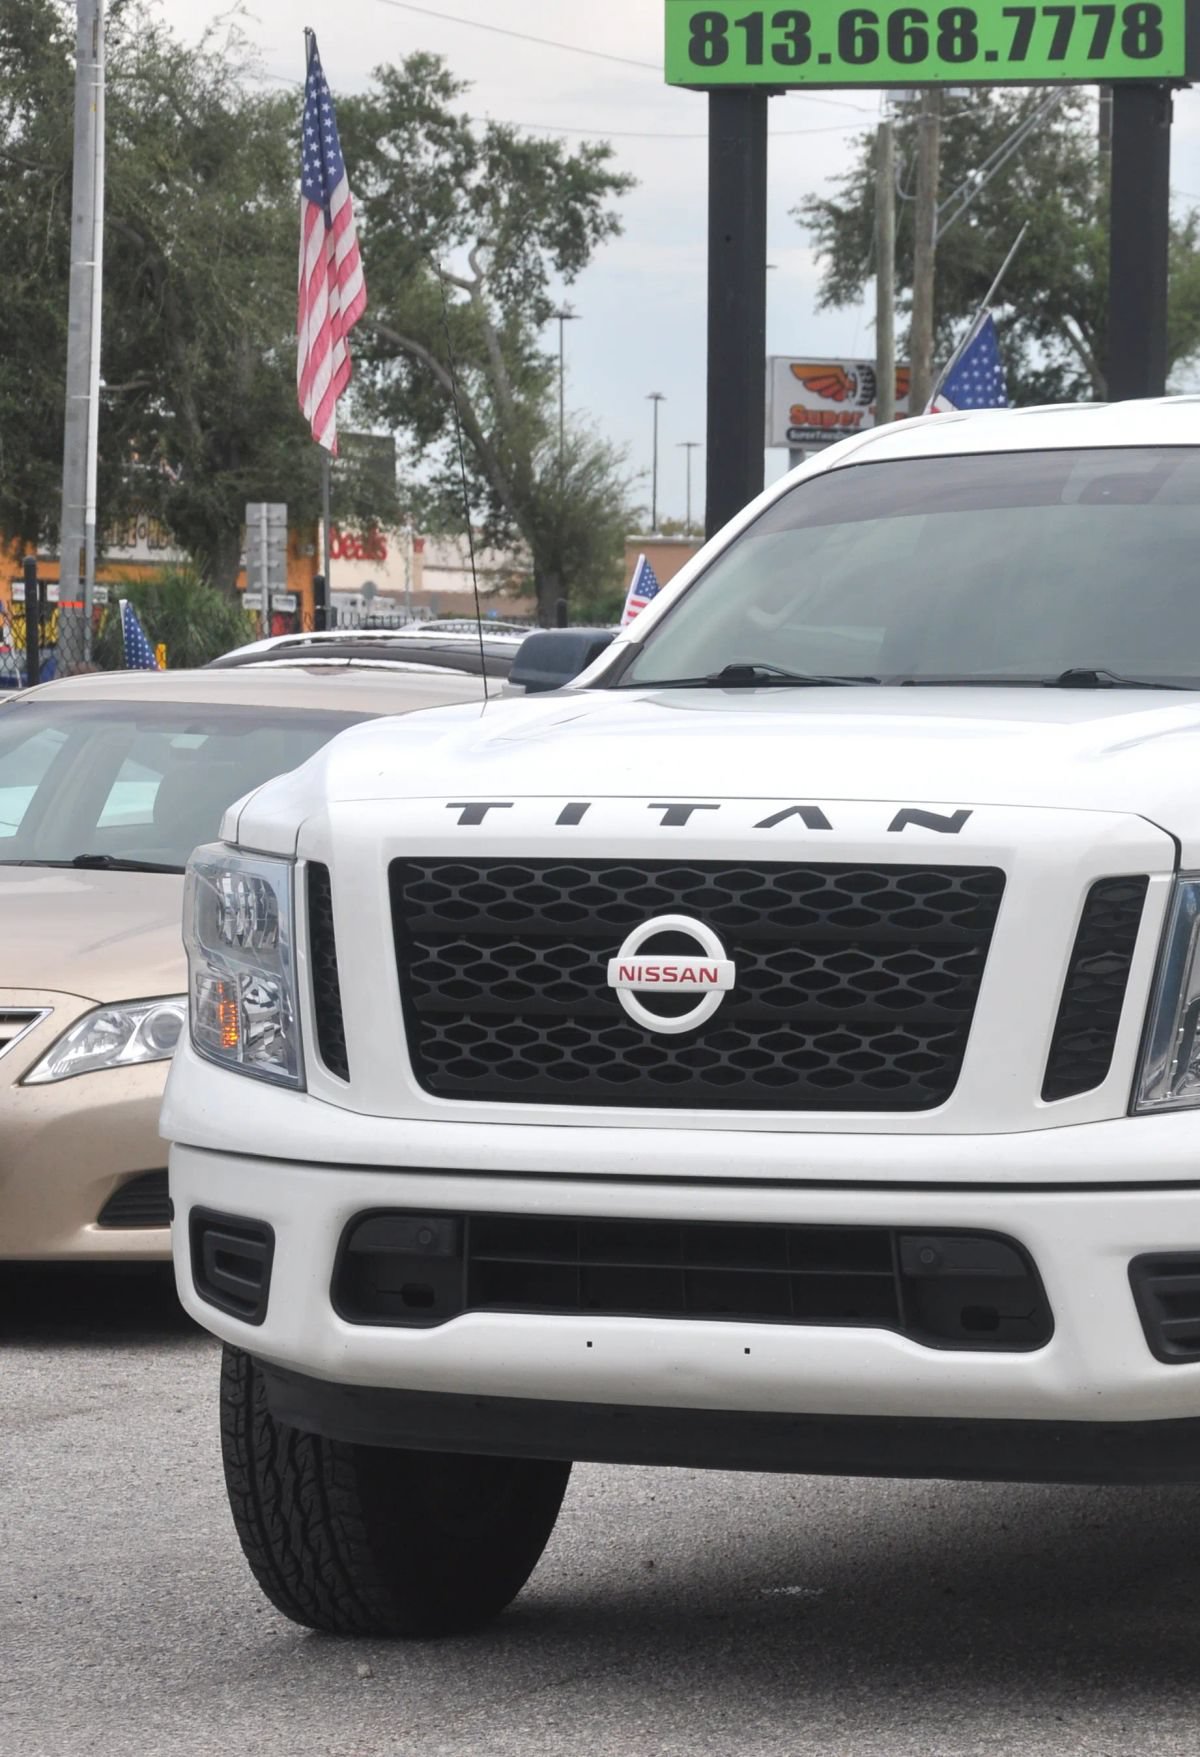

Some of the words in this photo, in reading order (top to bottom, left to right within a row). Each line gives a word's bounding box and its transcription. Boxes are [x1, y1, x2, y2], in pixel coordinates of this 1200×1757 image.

[687, 2, 1164, 67] 813.668.7778
[789, 404, 864, 428] Super
[445, 802, 974, 834] TITAN
[618, 965, 719, 984] NISSAN
